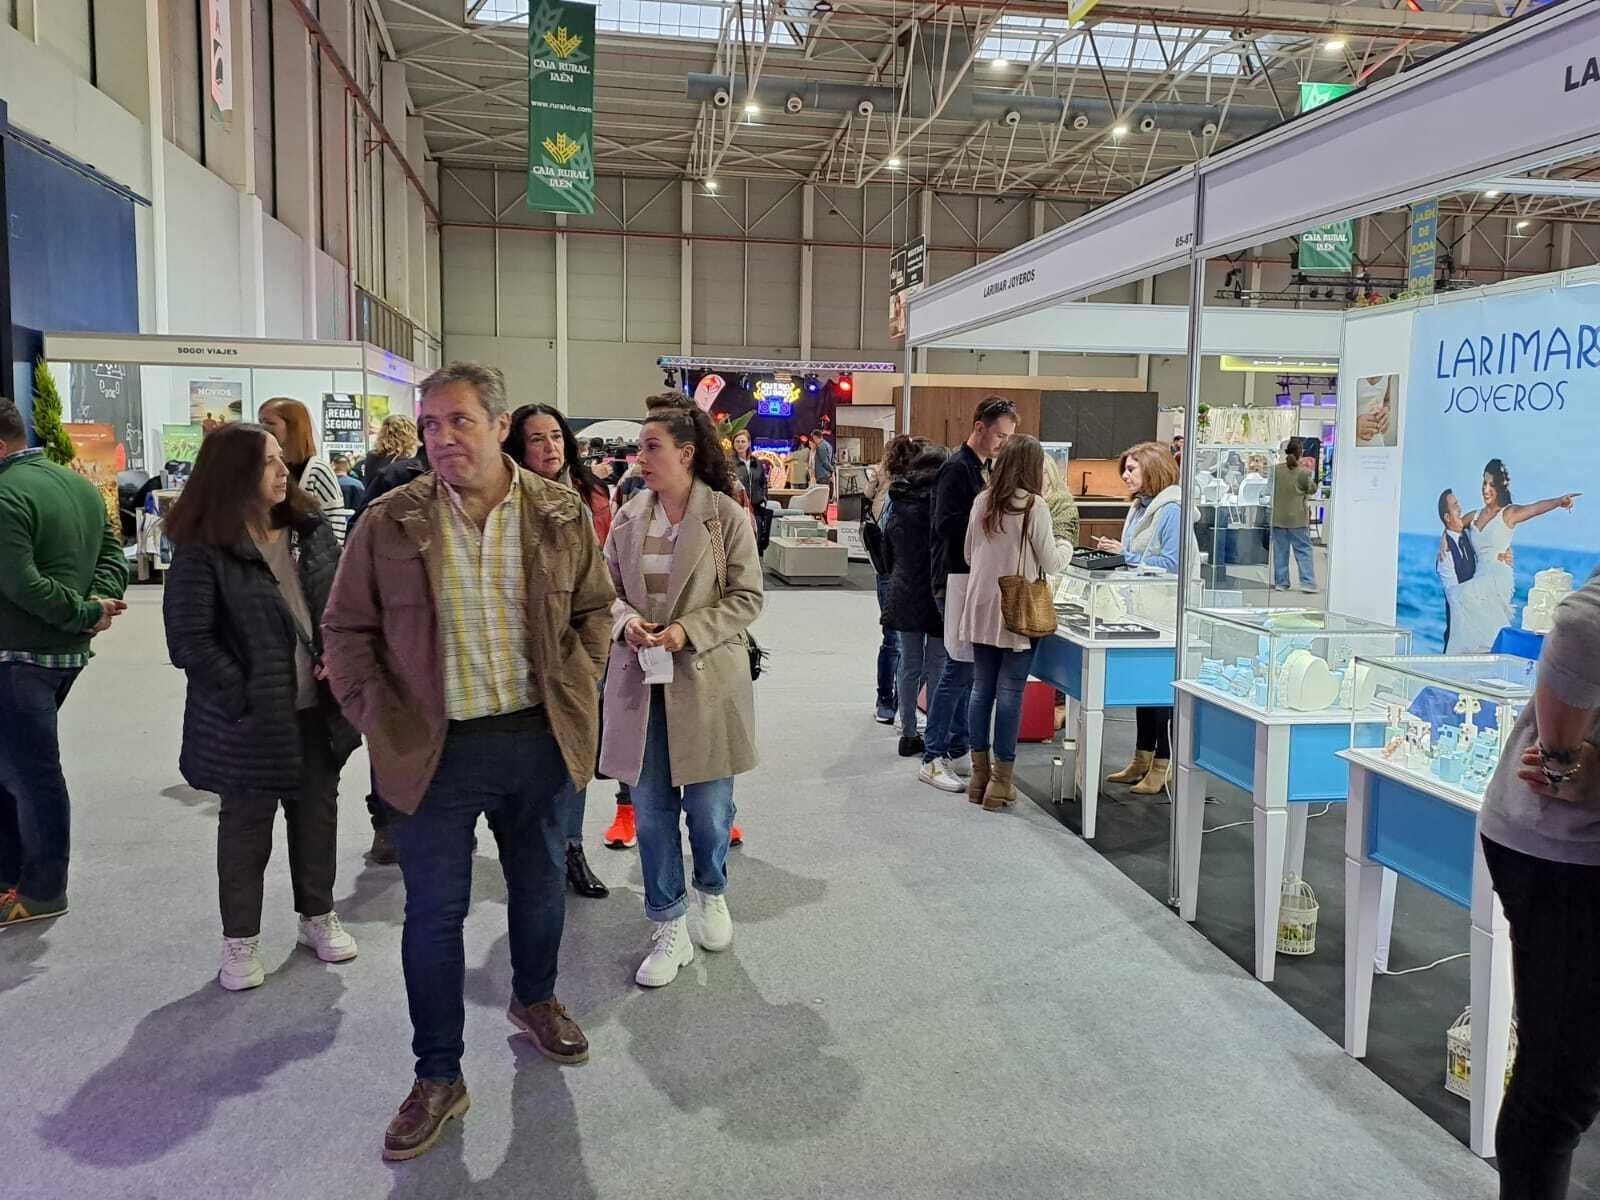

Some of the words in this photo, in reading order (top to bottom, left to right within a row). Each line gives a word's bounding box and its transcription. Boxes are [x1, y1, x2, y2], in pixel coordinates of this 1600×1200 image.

[558, 62, 591, 74] RURAL
[531, 101, 592, 113] www.ruralvia.com
[557, 168, 590, 180] RURAL
[983, 279, 1007, 298] LARIMAR
[1008, 268, 1035, 290] JOYEROS
[206, 348, 238, 356] VIAJES
[1443, 380, 1569, 414] JOYEROS
[325, 418, 362, 431] SEGURO!
